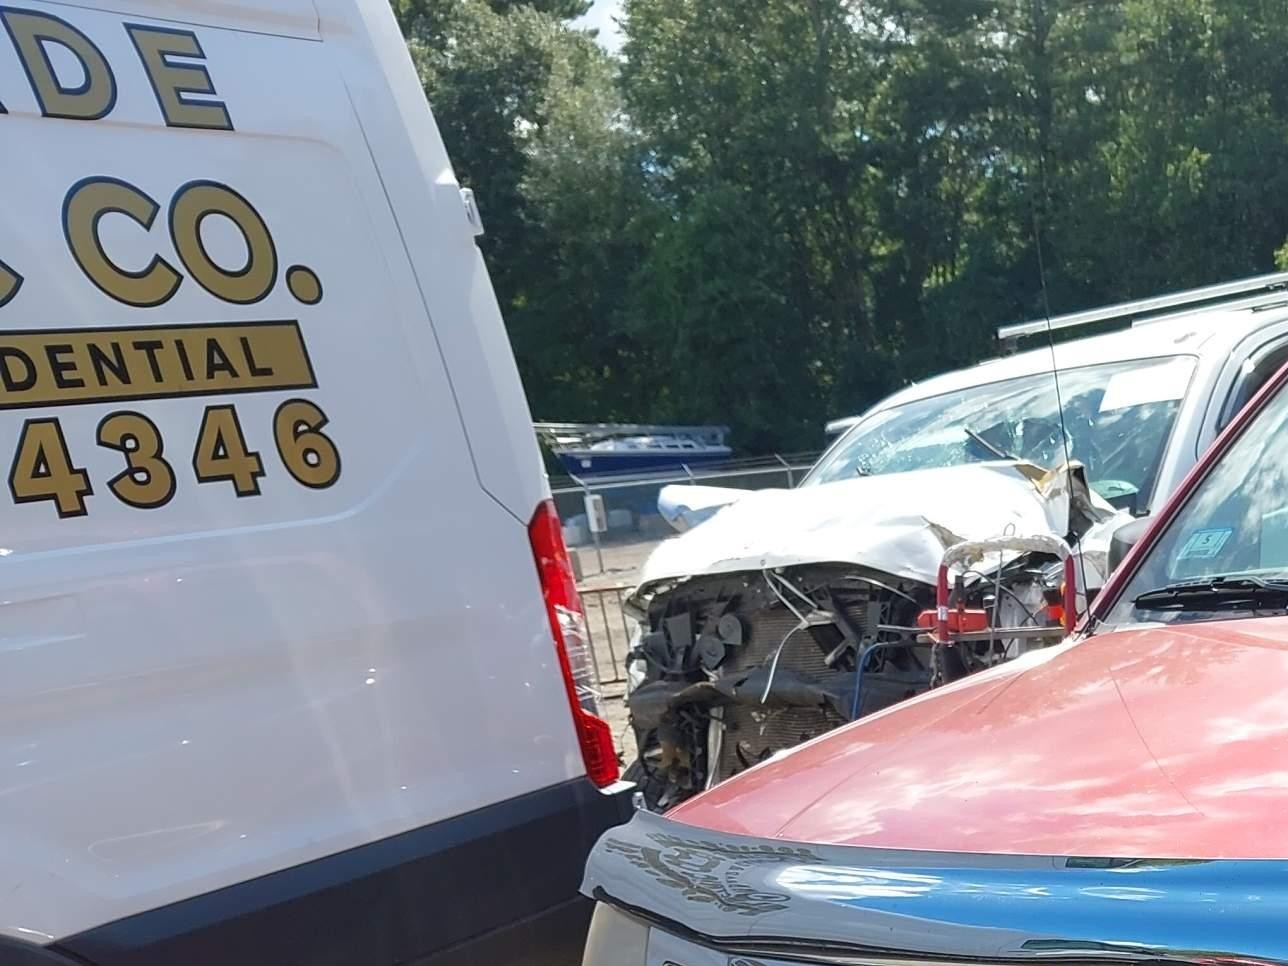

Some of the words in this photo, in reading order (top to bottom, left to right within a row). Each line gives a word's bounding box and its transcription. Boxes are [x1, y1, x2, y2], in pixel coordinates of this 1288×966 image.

[0, 5, 235, 131] DE
[61, 175, 323, 308] CO.
[0, 336, 273, 393] DENTIAL
[8, 398, 341, 519] 4346
